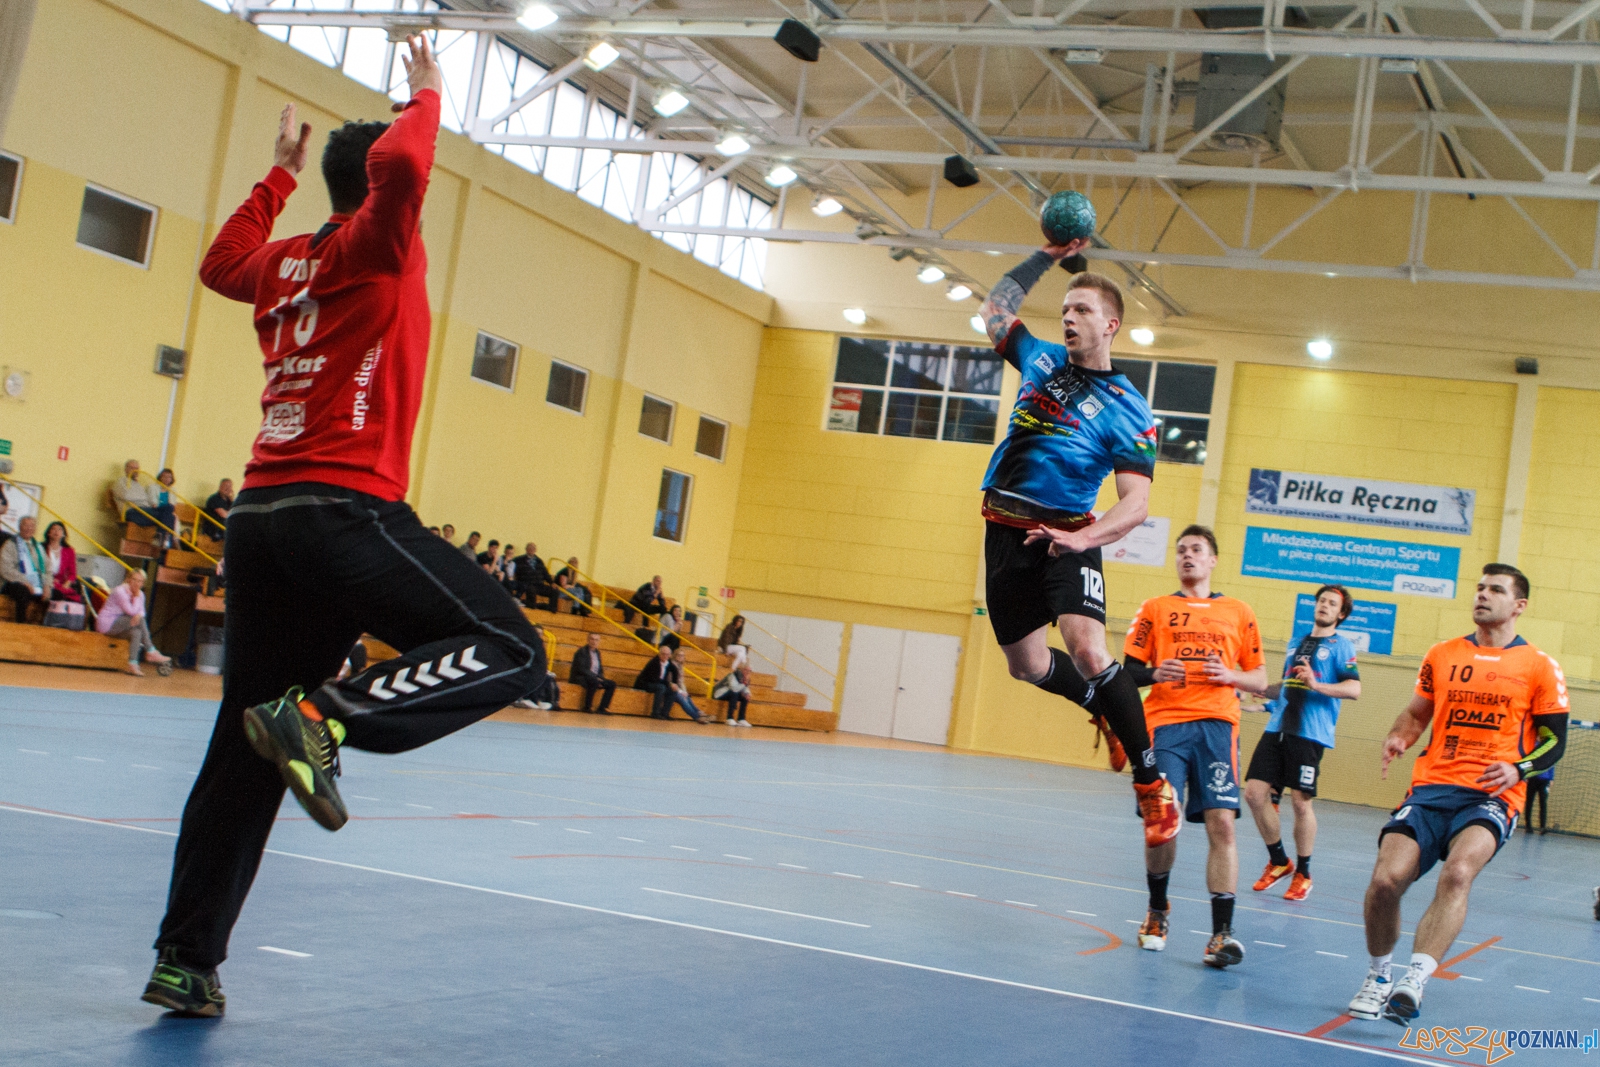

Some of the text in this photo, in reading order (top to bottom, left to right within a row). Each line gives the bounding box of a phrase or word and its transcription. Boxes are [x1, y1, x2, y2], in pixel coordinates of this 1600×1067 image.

[351, 347, 375, 430] carpe diem
[1032, 390, 1081, 431] VEOLIA
[1284, 479, 1438, 514] Piłka Ręczna
[1346, 514, 1410, 527] Handball
[1262, 531, 1441, 562] Młodzieżowe Centrum Sportu
[1278, 549, 1288, 558] w
[1289, 549, 1314, 561] piłce
[1314, 552, 1350, 566] ręcznej
[1356, 556, 1420, 572] koszykówce
[1080, 565, 1105, 605] 10
[1169, 612, 1190, 627] 27
[1172, 631, 1226, 645] BESTTHERAPY
[1448, 664, 1474, 683] 10
[1448, 689, 1514, 708] BESTTHERAPY
[1446, 708, 1507, 730] JOMAT
